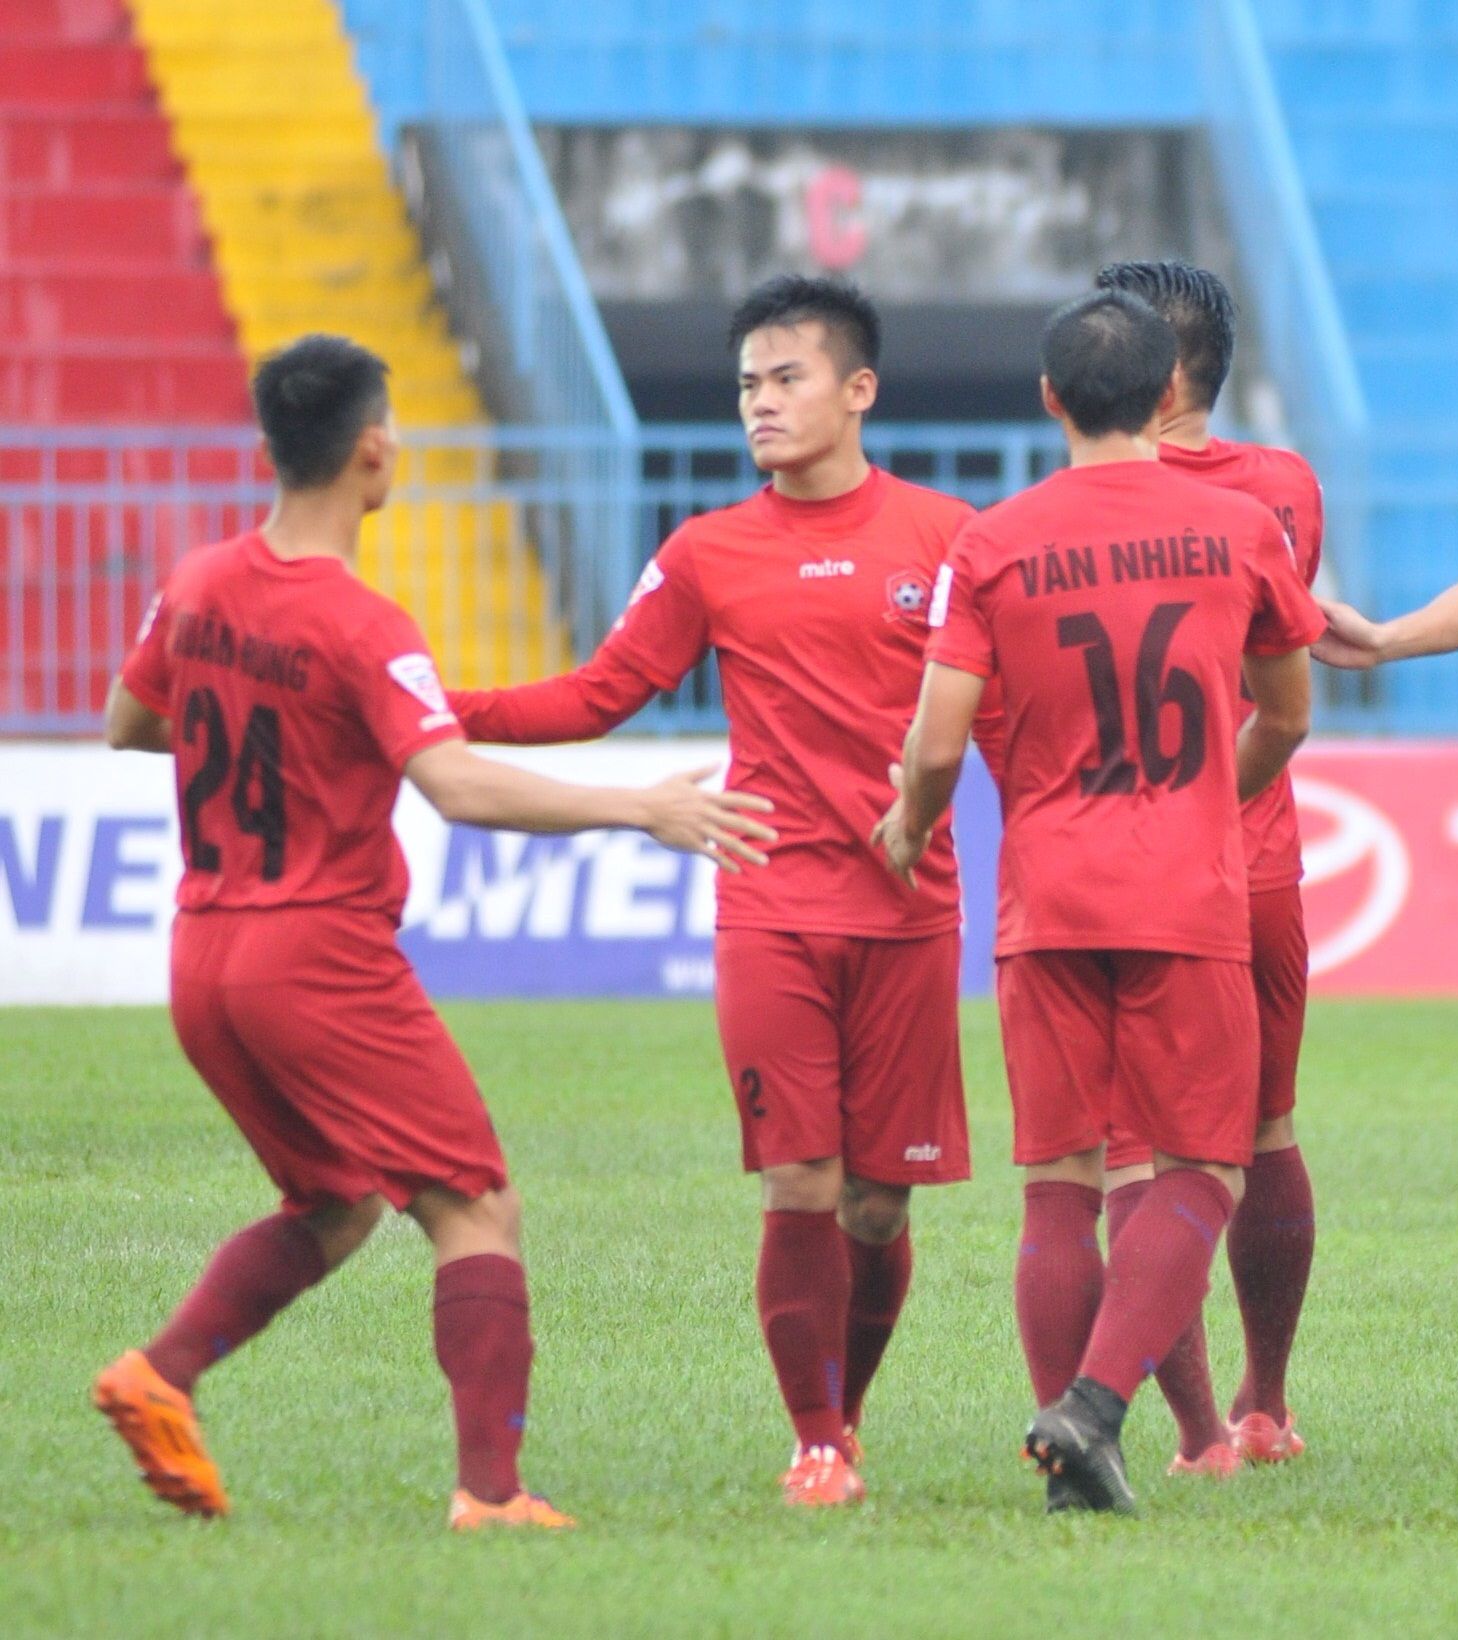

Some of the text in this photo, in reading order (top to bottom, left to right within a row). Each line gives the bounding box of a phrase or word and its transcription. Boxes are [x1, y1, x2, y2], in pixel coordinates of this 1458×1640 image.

[799, 558, 856, 580] mitre
[1018, 527, 1232, 598] VĂN NHIÊN
[1056, 602, 1207, 796] 16
[182, 685, 286, 882] 24
[740, 1066, 767, 1118] 2
